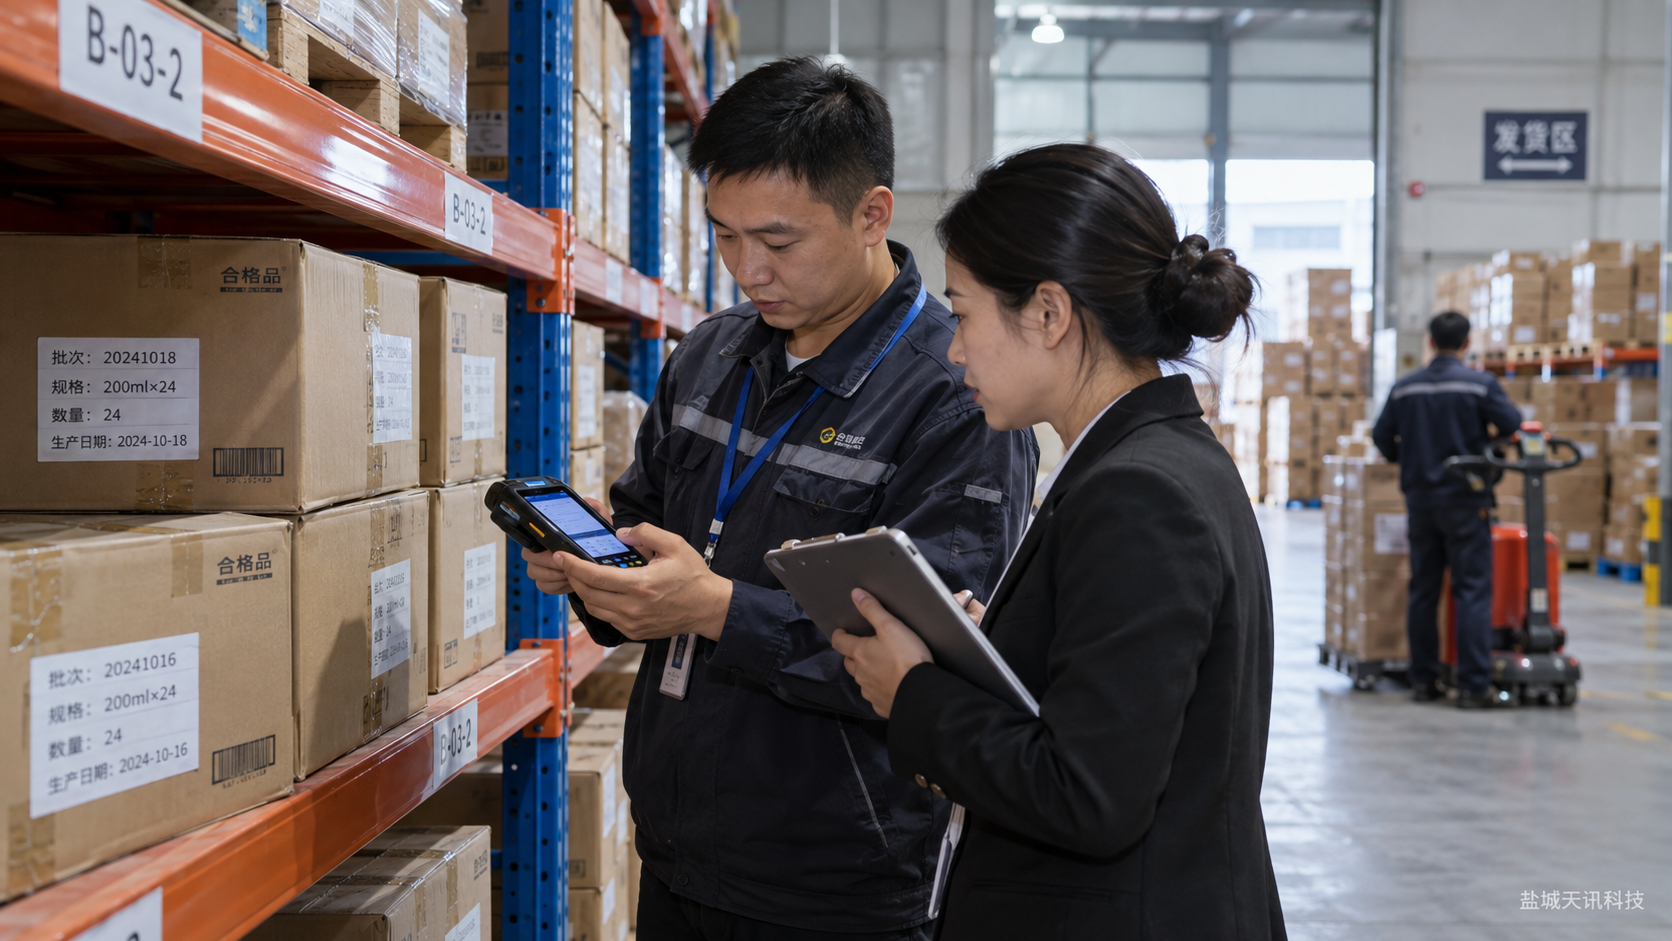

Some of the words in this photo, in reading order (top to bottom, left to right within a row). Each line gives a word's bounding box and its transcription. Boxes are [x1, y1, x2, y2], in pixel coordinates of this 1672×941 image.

[88, 4, 183, 101] B-03-2
[1492, 119, 1578, 154] 发货区
[453, 193, 486, 235] B-03-2
[221, 266, 281, 284] 合格品
[104, 351, 176, 364] 20241018
[103, 408, 121, 421] 24
[117, 434, 187, 447] 2024-10-18
[217, 552, 271, 575] 合格品
[104, 652, 177, 678] 20241016
[104, 728, 122, 746] 24
[441, 718, 471, 766] B-03-2
[119, 742, 188, 774] 2024-10-16
